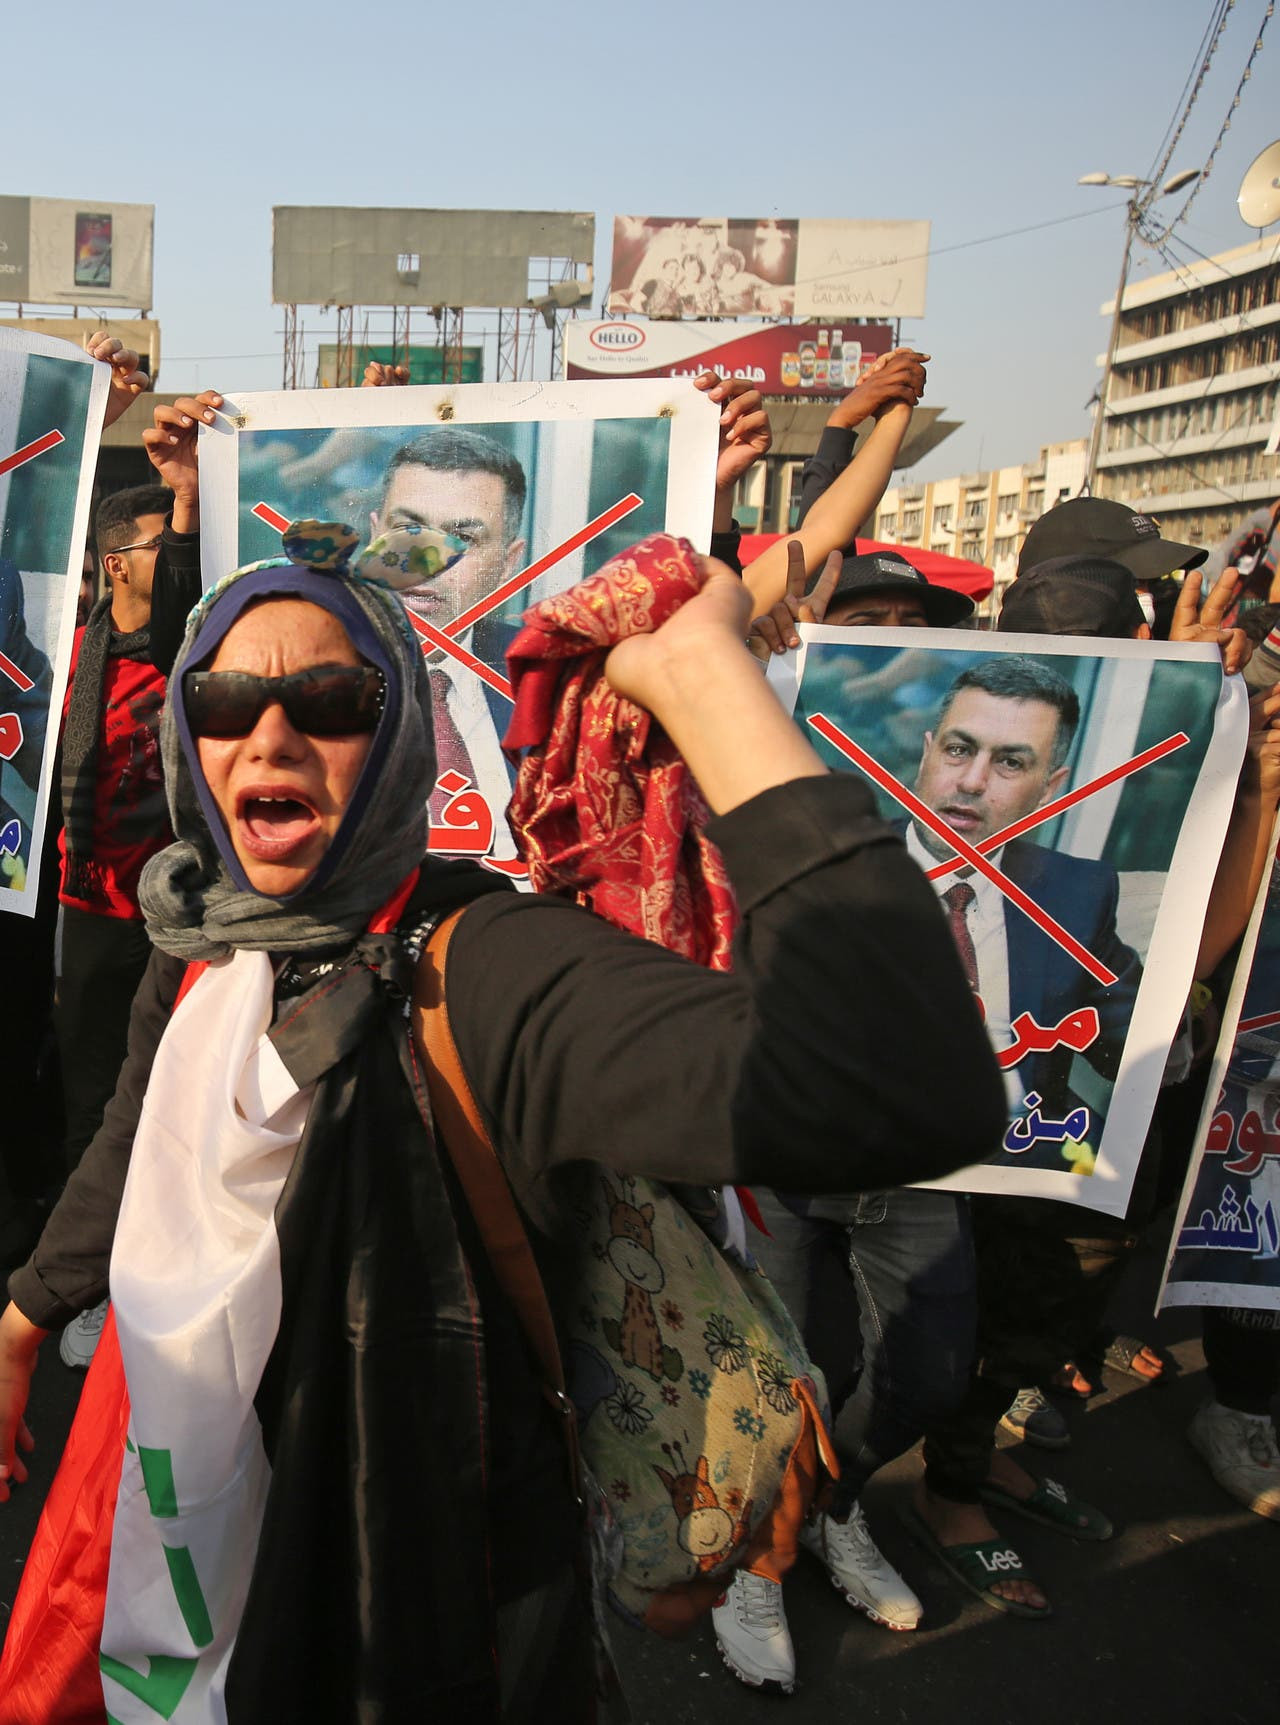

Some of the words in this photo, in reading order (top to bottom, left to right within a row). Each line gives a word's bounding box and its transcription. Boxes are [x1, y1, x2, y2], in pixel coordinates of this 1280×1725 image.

[598, 333, 638, 344] HELLO
[1002, 1090, 1090, 1154] من
[1175, 1183, 1279, 1254] الشع
[976, 1549, 1022, 1571] Lee
